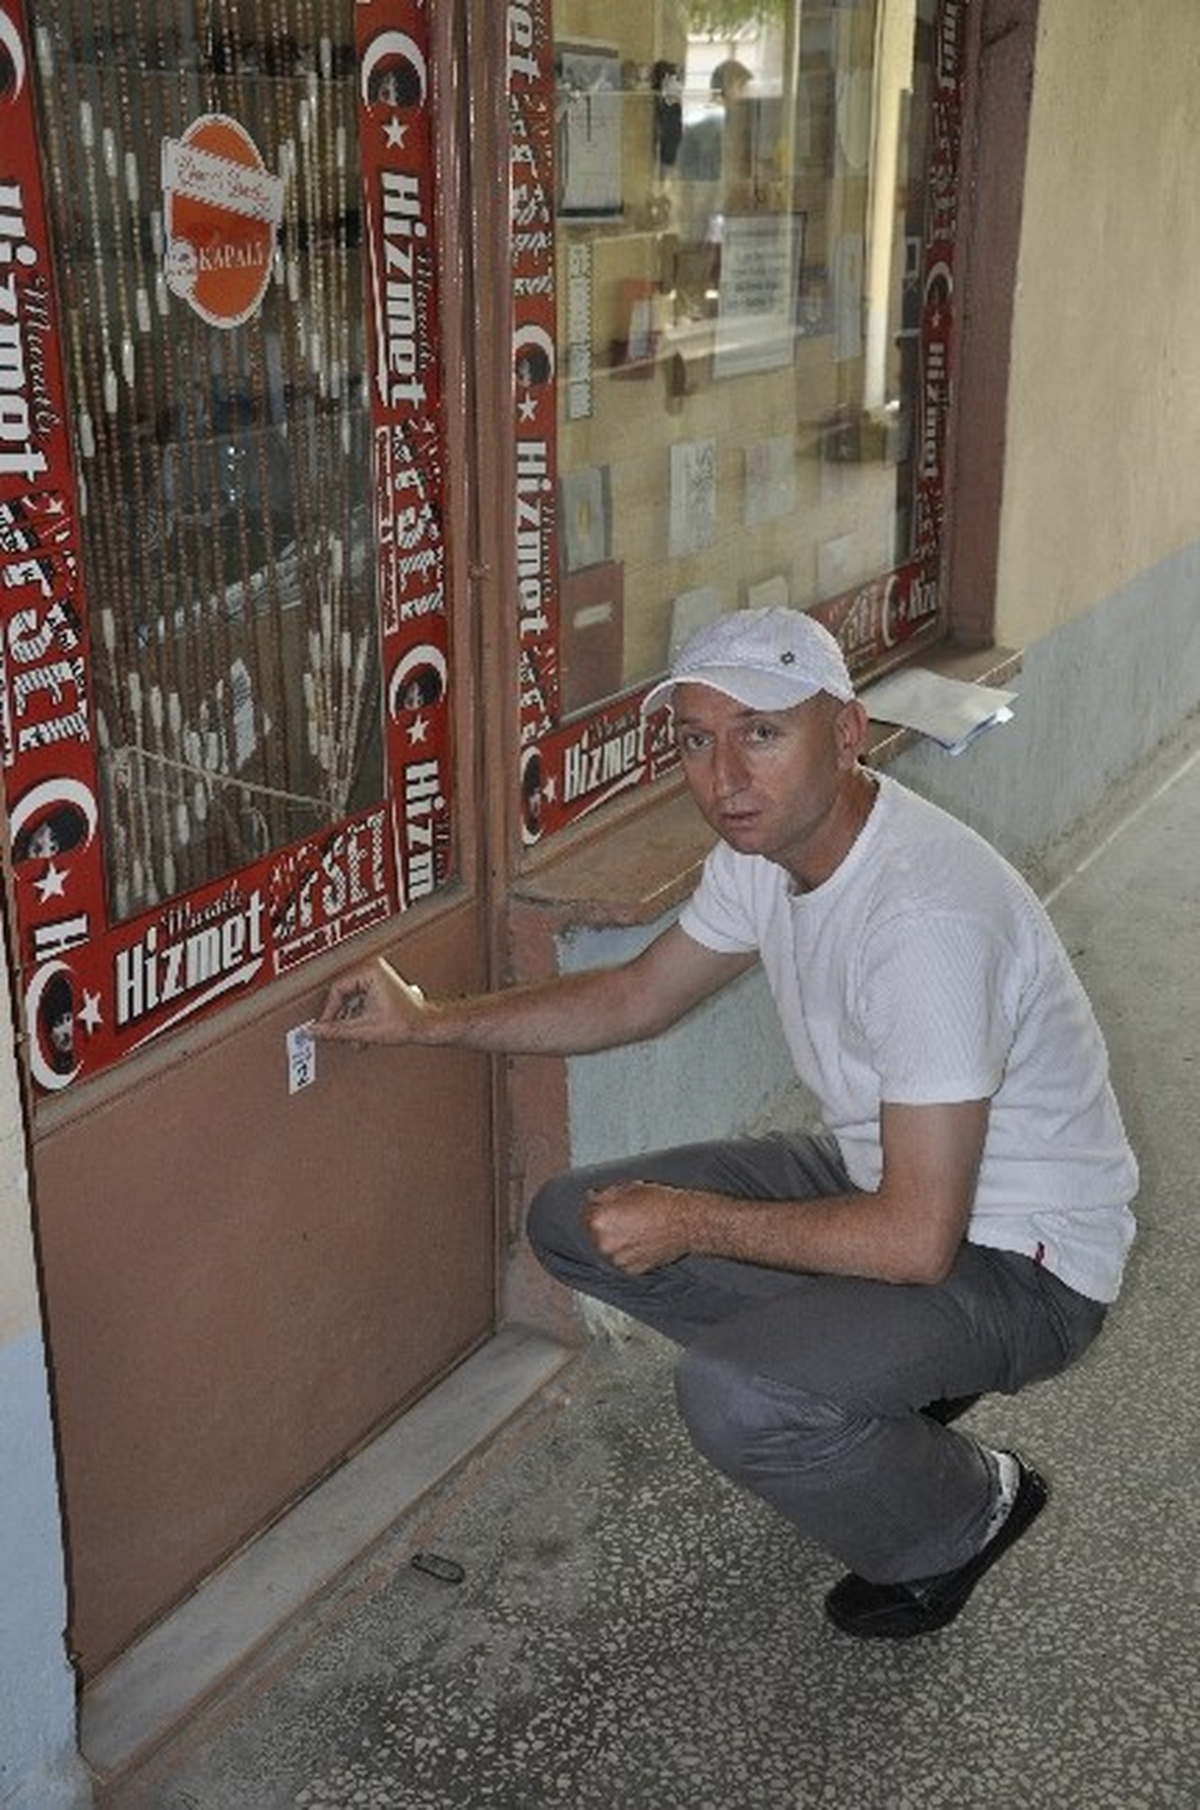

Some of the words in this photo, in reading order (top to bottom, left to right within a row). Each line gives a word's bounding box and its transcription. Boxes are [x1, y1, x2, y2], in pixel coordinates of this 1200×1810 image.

[199, 241, 264, 271] KAPALI
[379, 171, 428, 410] Hizmet
[515, 441, 552, 637] Hizmet
[564, 714, 648, 802] Hizmet
[405, 759, 446, 902] Hizm
[116, 889, 266, 1027] Hizmet
